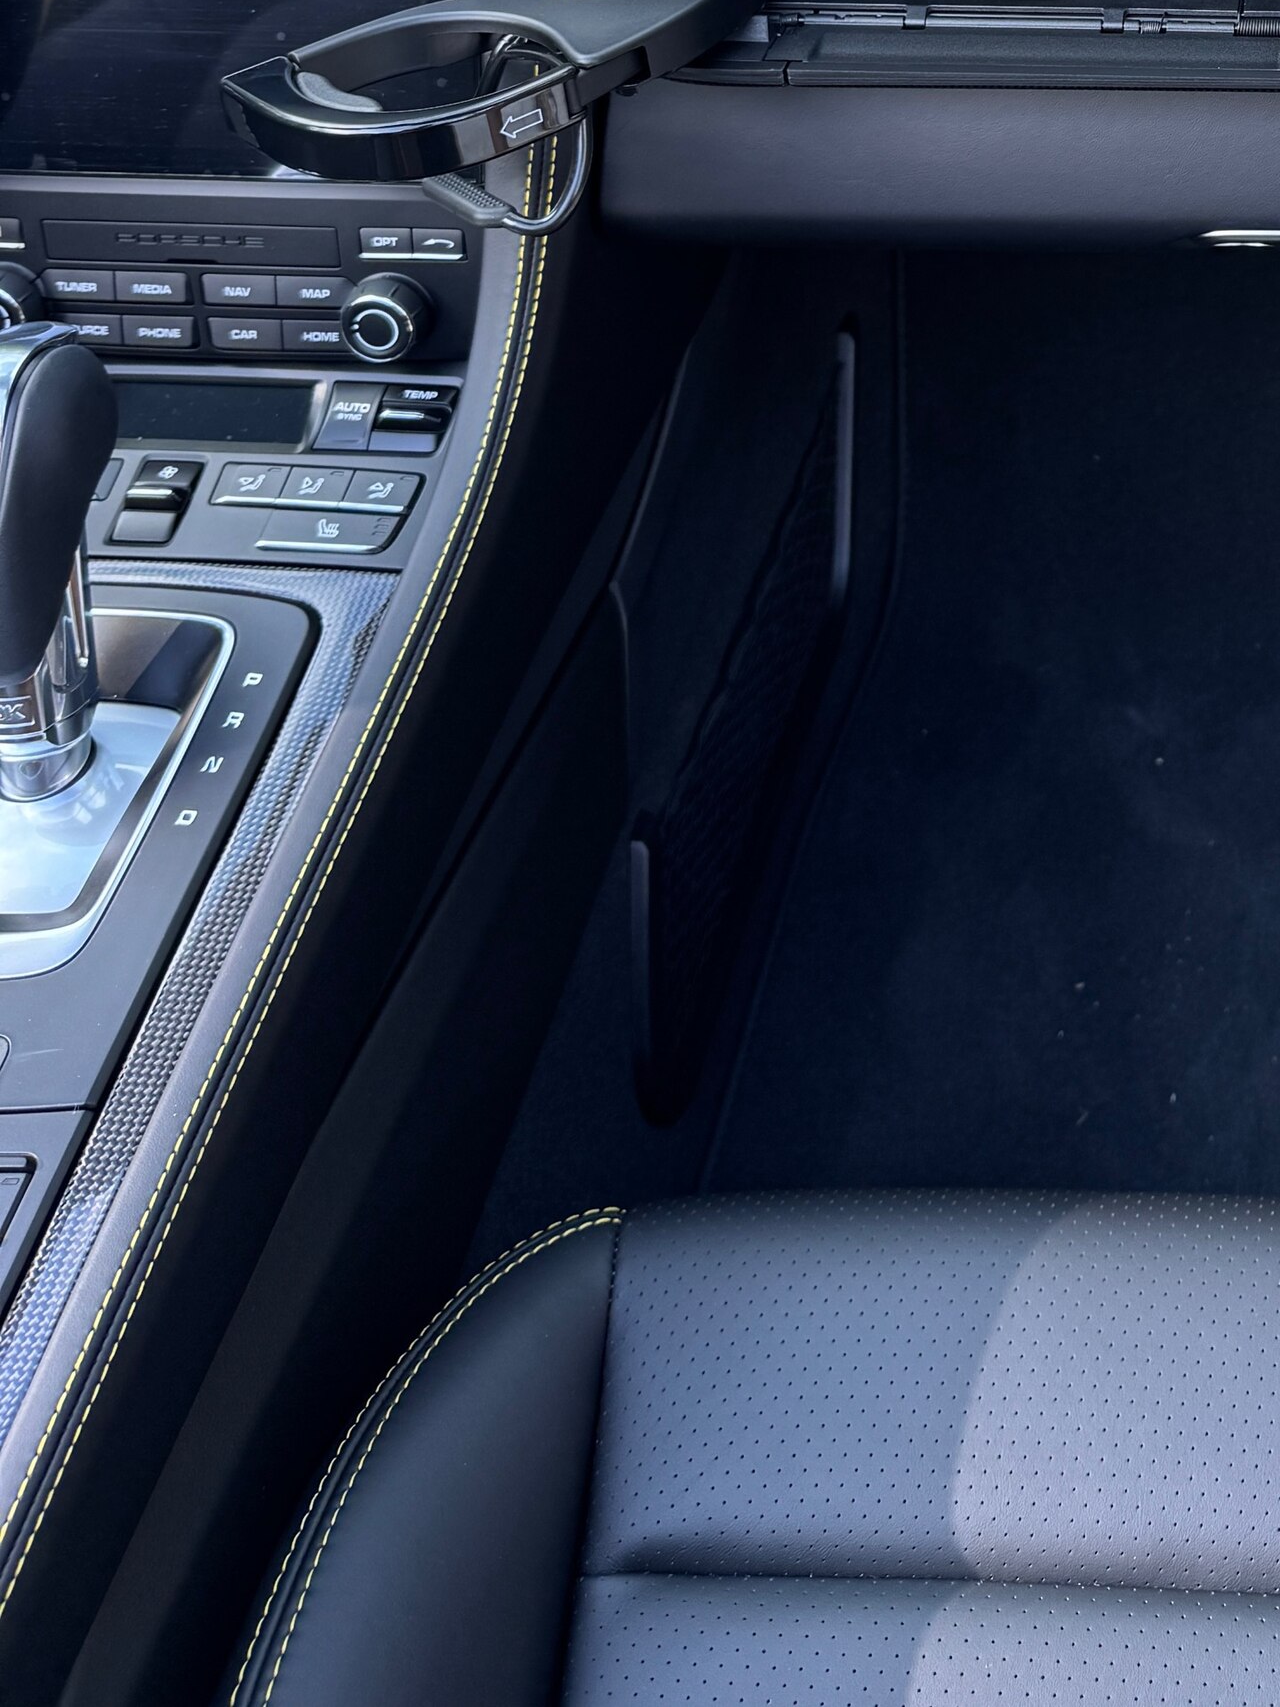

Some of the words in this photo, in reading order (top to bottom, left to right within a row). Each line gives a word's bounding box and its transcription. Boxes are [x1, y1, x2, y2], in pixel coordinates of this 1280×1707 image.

[115, 232, 265, 248] PORSCHE
[372, 236, 399, 248] OPT
[55, 281, 98, 293] TUNER
[132, 283, 172, 295] MEDIA
[223, 286, 251, 297] NAV
[301, 288, 331, 299] MAP
[138, 327, 182, 339] PHONE
[230, 329, 258, 340] CAR
[303, 331, 340, 342] HOME
[402, 389, 439, 400] TEMP
[332, 401, 371, 414] AUTO
[336, 413, 362, 421] SYNC
[242, 672, 264, 688] P
[221, 711, 245, 730] R
[200, 755, 224, 774] N
[174, 809, 198, 827] D
